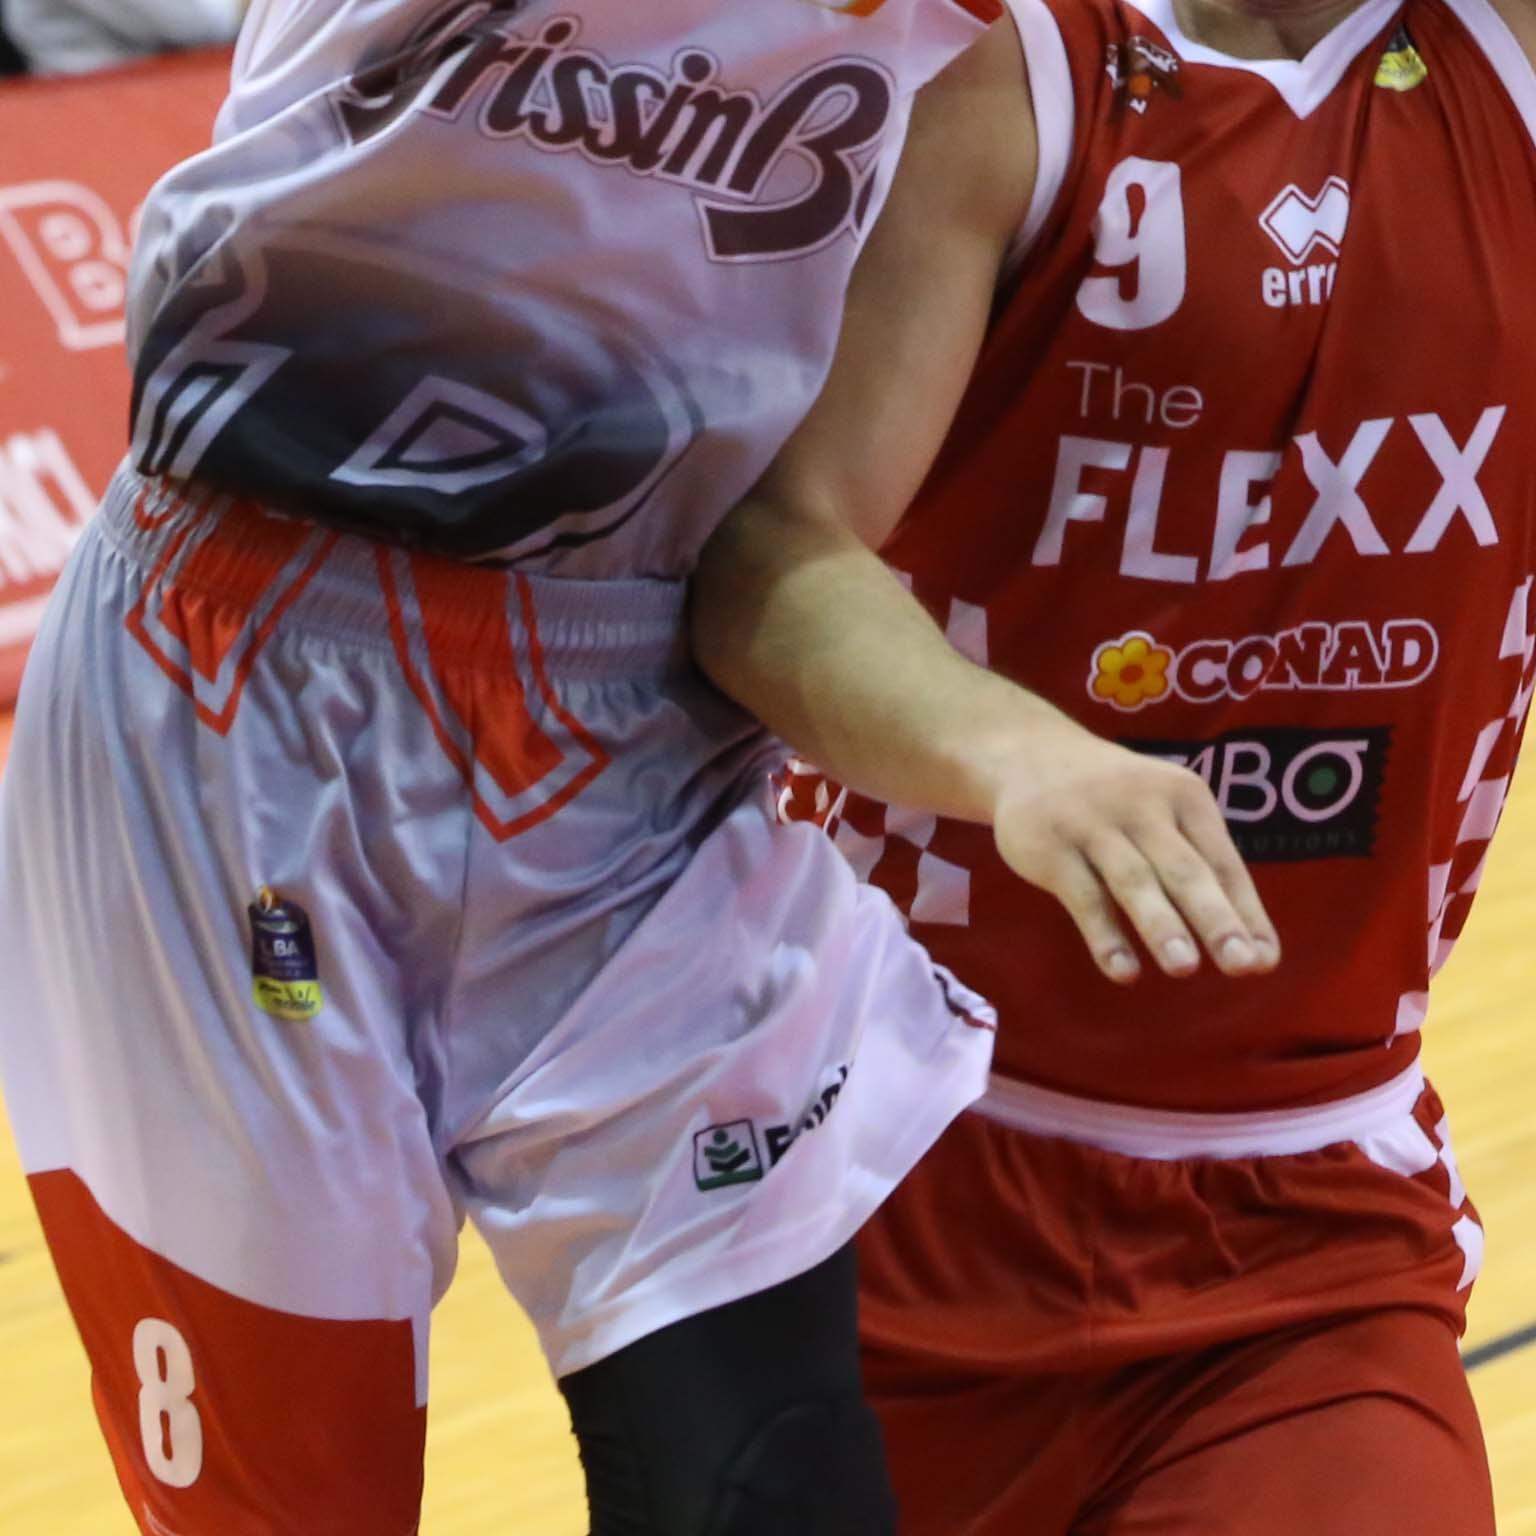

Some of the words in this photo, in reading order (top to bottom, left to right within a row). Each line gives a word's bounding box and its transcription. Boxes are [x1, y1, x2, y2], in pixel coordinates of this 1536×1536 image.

[1075, 155, 1187, 331] 9
[1066, 360, 1204, 428] The
[1031, 405, 1507, 585] FLEXX
[1168, 617, 1442, 703] CONAD
[131, 1317, 203, 1489] 8
